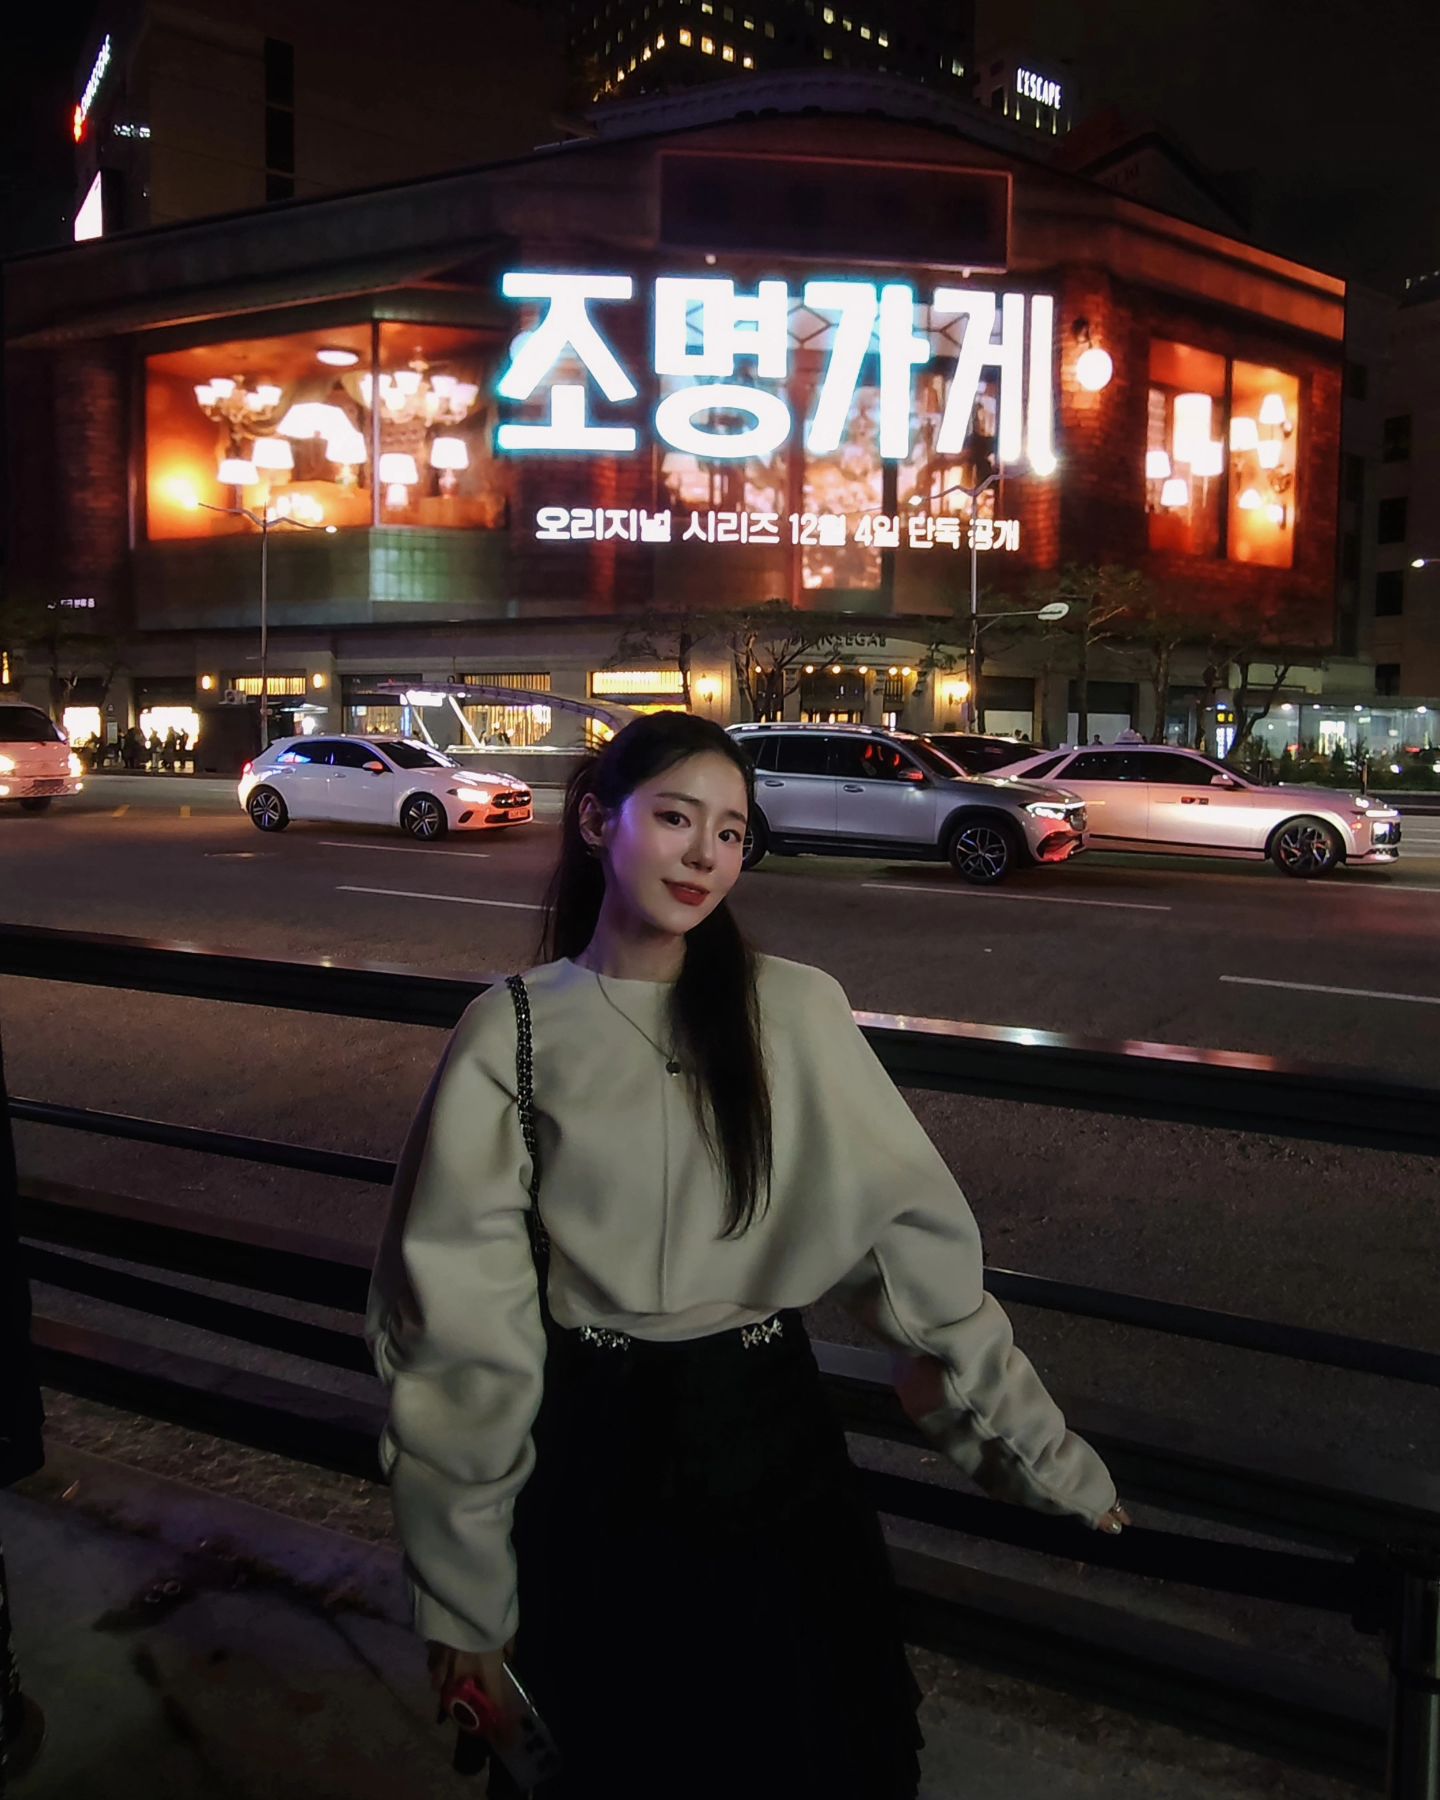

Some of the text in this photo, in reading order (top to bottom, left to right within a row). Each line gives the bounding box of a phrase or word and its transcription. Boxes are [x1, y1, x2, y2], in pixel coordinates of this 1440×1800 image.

[1016, 67, 1061, 110] L'ESCAPE
[498, 272, 1058, 468] 조명가게
[535, 507, 1020, 552] 오리지널 시리즈 12월 4일 단독 공개
